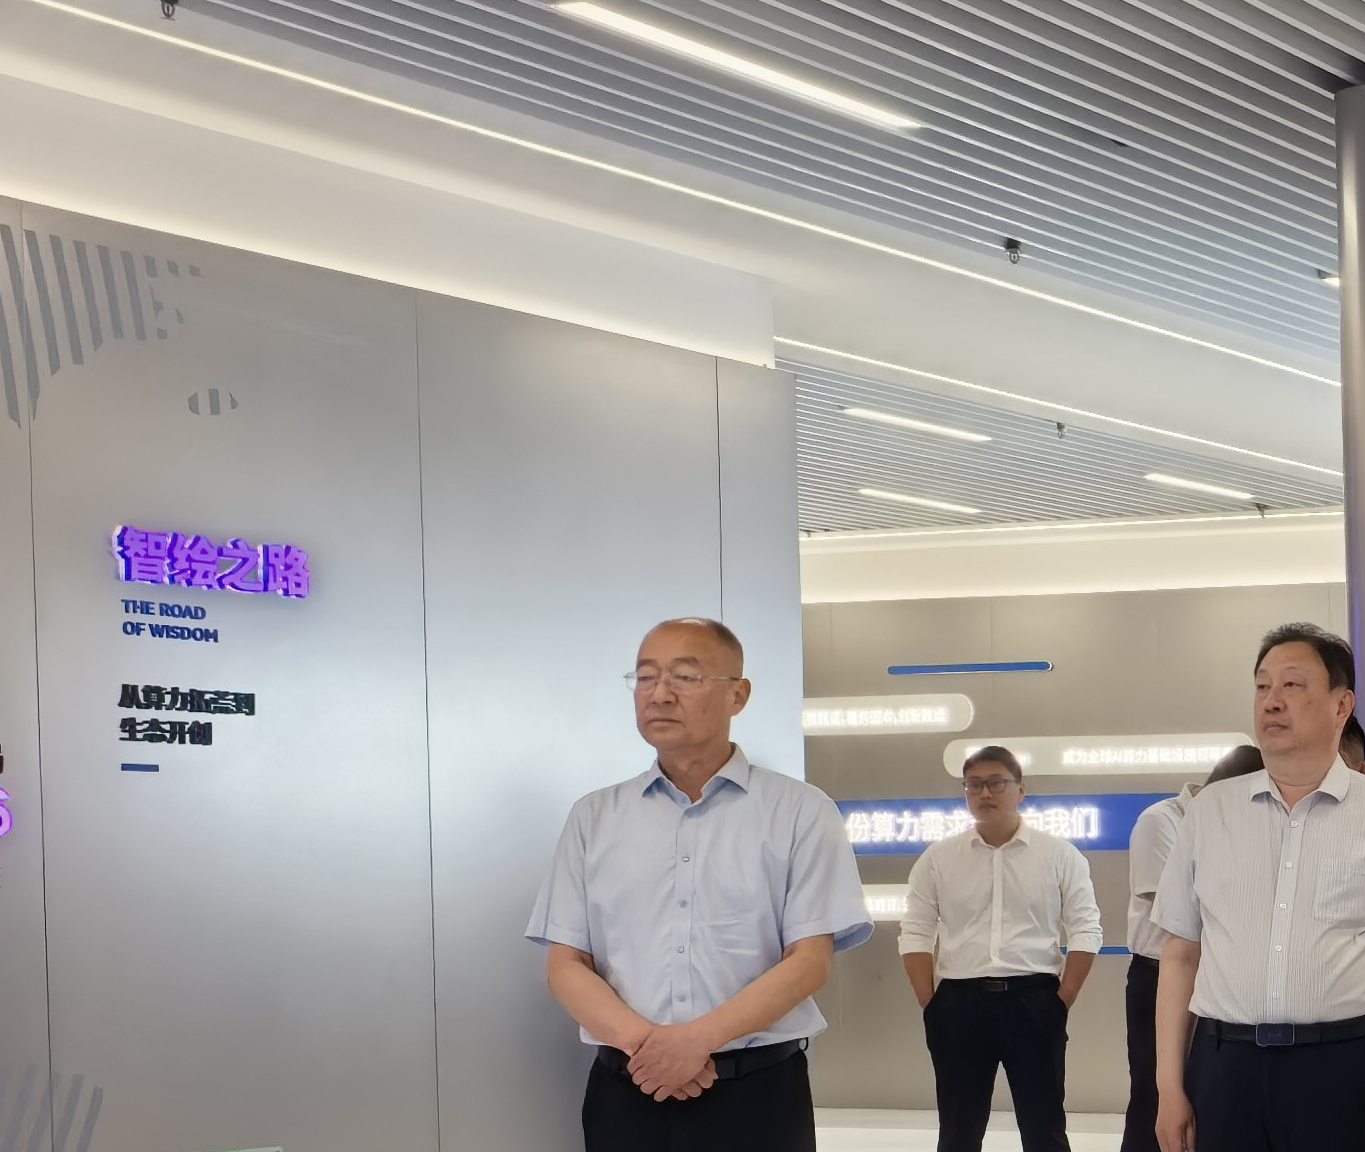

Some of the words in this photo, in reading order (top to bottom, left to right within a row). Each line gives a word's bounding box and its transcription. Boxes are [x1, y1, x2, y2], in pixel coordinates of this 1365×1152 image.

[112, 525, 310, 598] 智绘之路
[121, 599, 155, 615] THE
[159, 602, 206, 620] ROAD
[122, 621, 146, 637] OF
[148, 624, 219, 643] WISDOM
[119, 717, 212, 745] 生态开创
